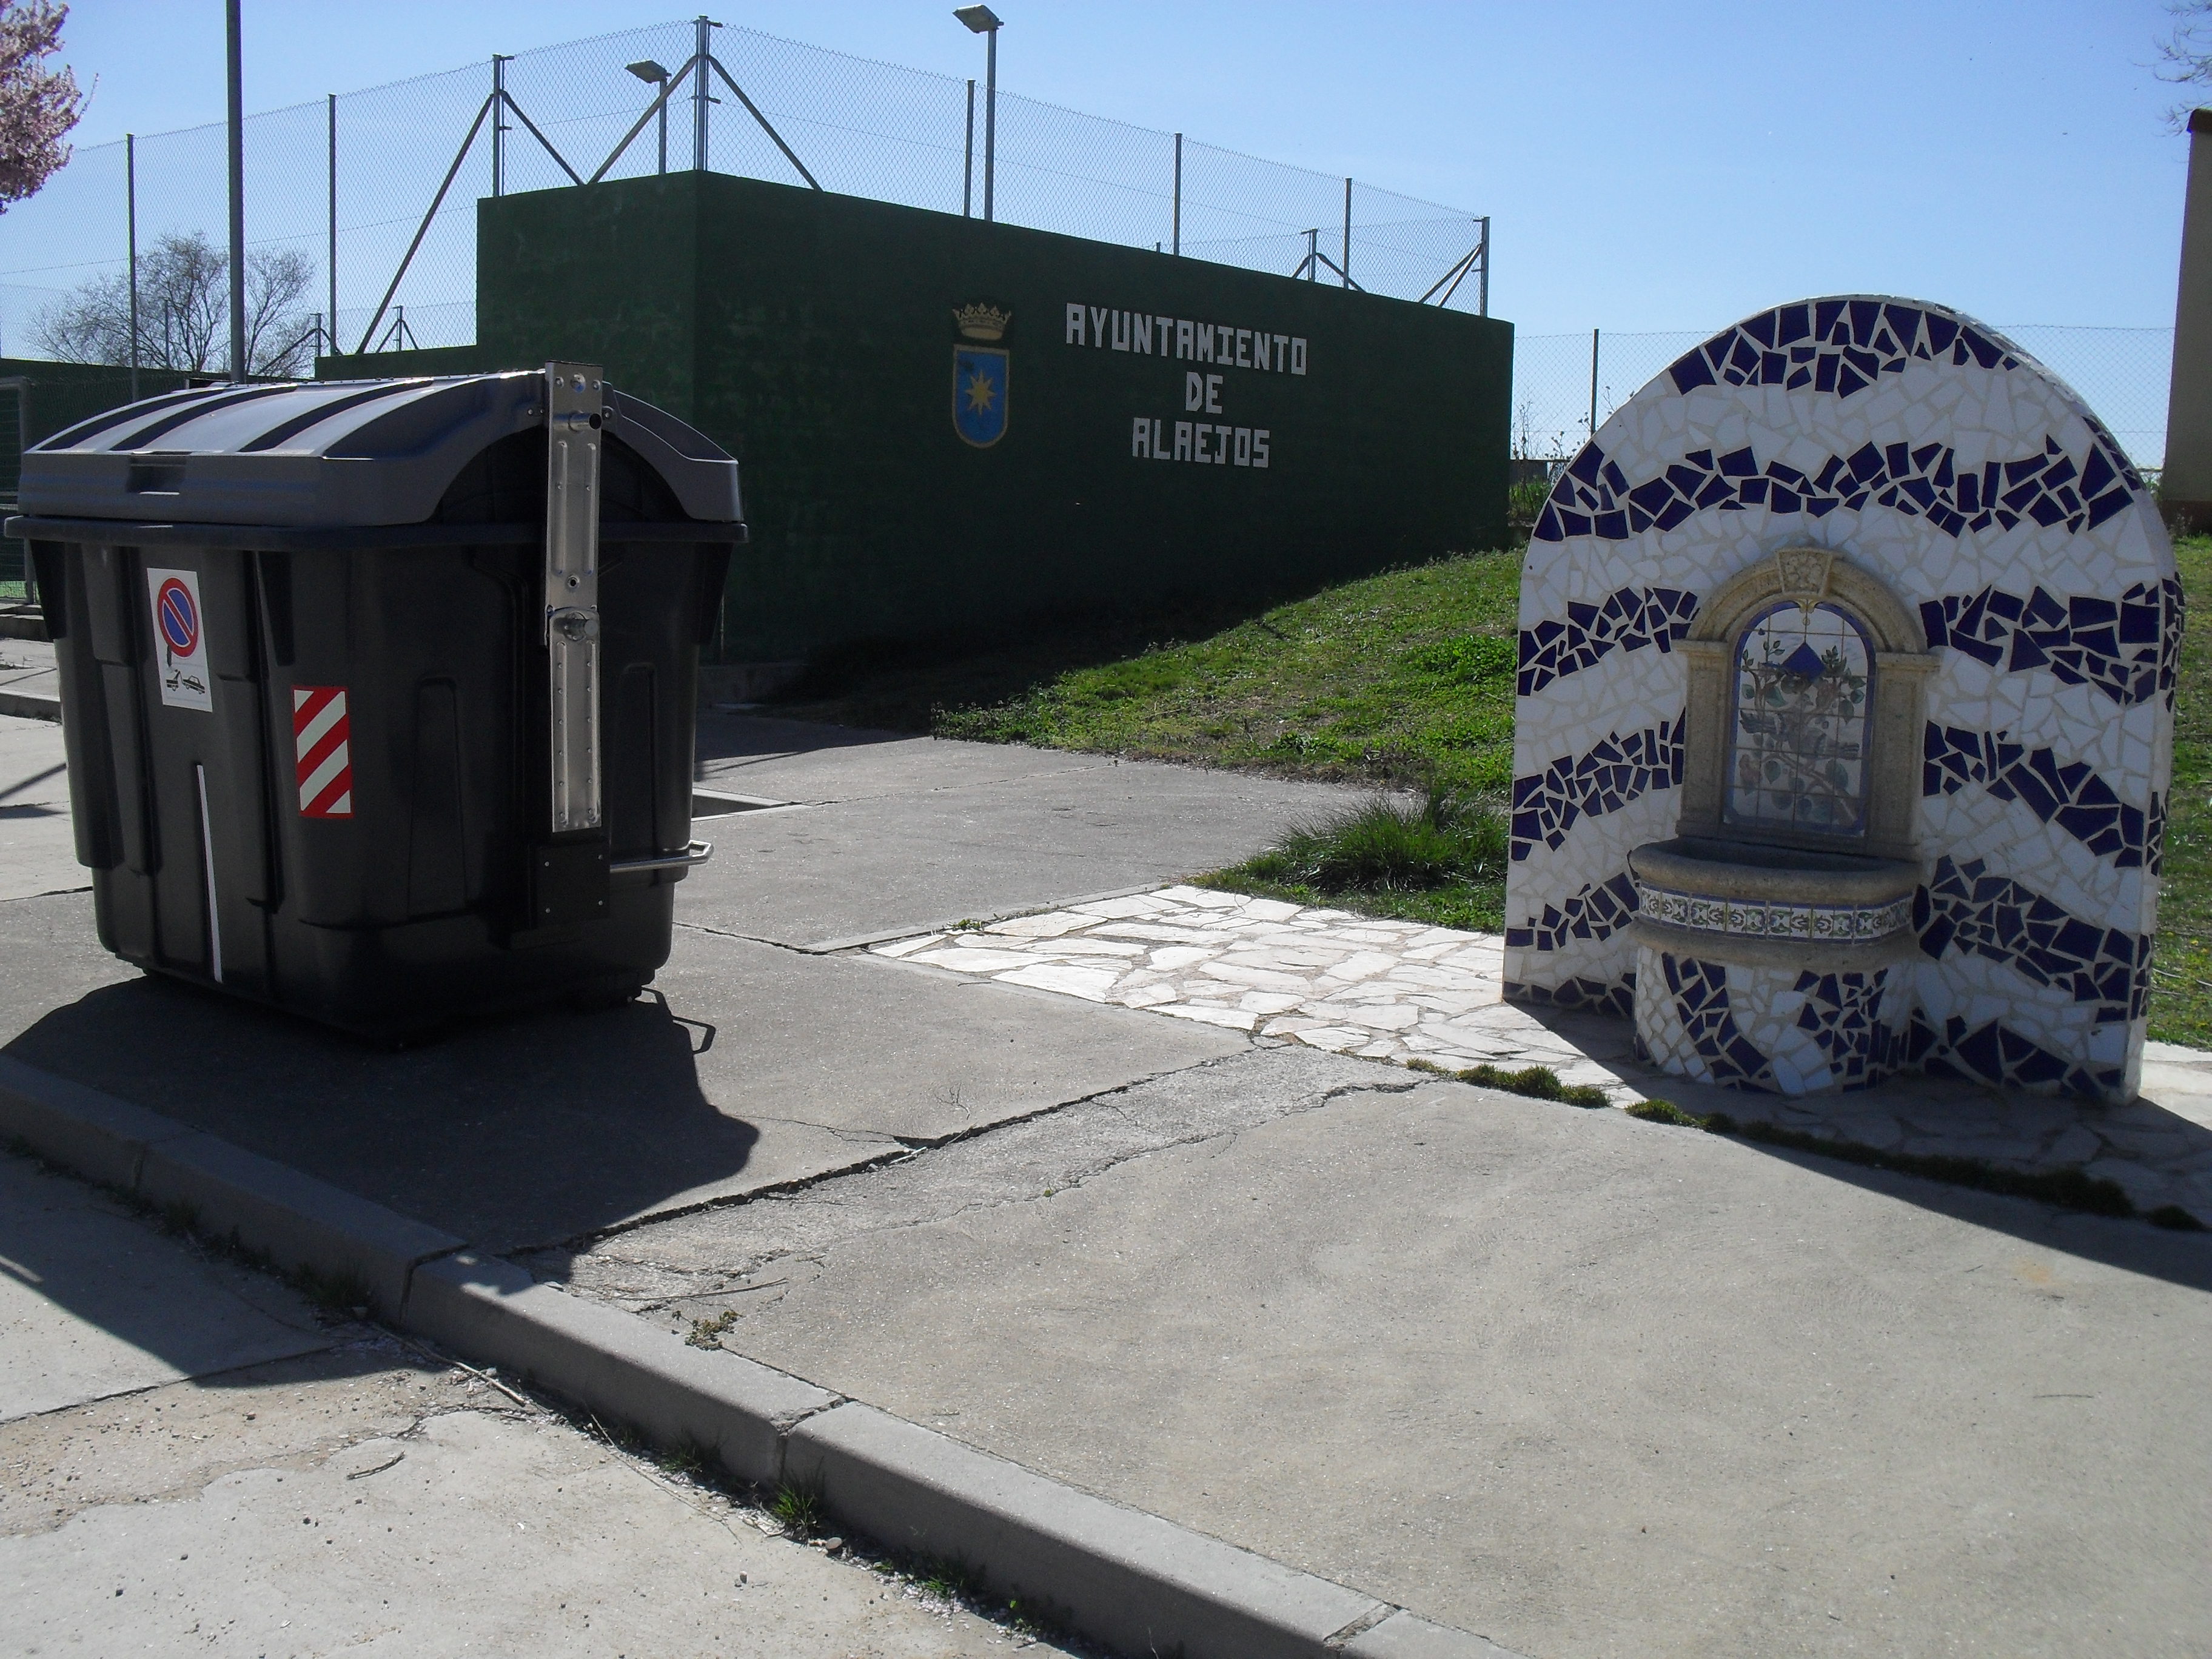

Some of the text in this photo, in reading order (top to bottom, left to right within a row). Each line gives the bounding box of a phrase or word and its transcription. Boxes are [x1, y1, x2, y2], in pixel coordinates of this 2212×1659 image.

[1066, 303, 1307, 375] AYUNTAMIENTO
[1185, 371, 1223, 414] DE
[1132, 417, 1270, 468] ALAEJOS
